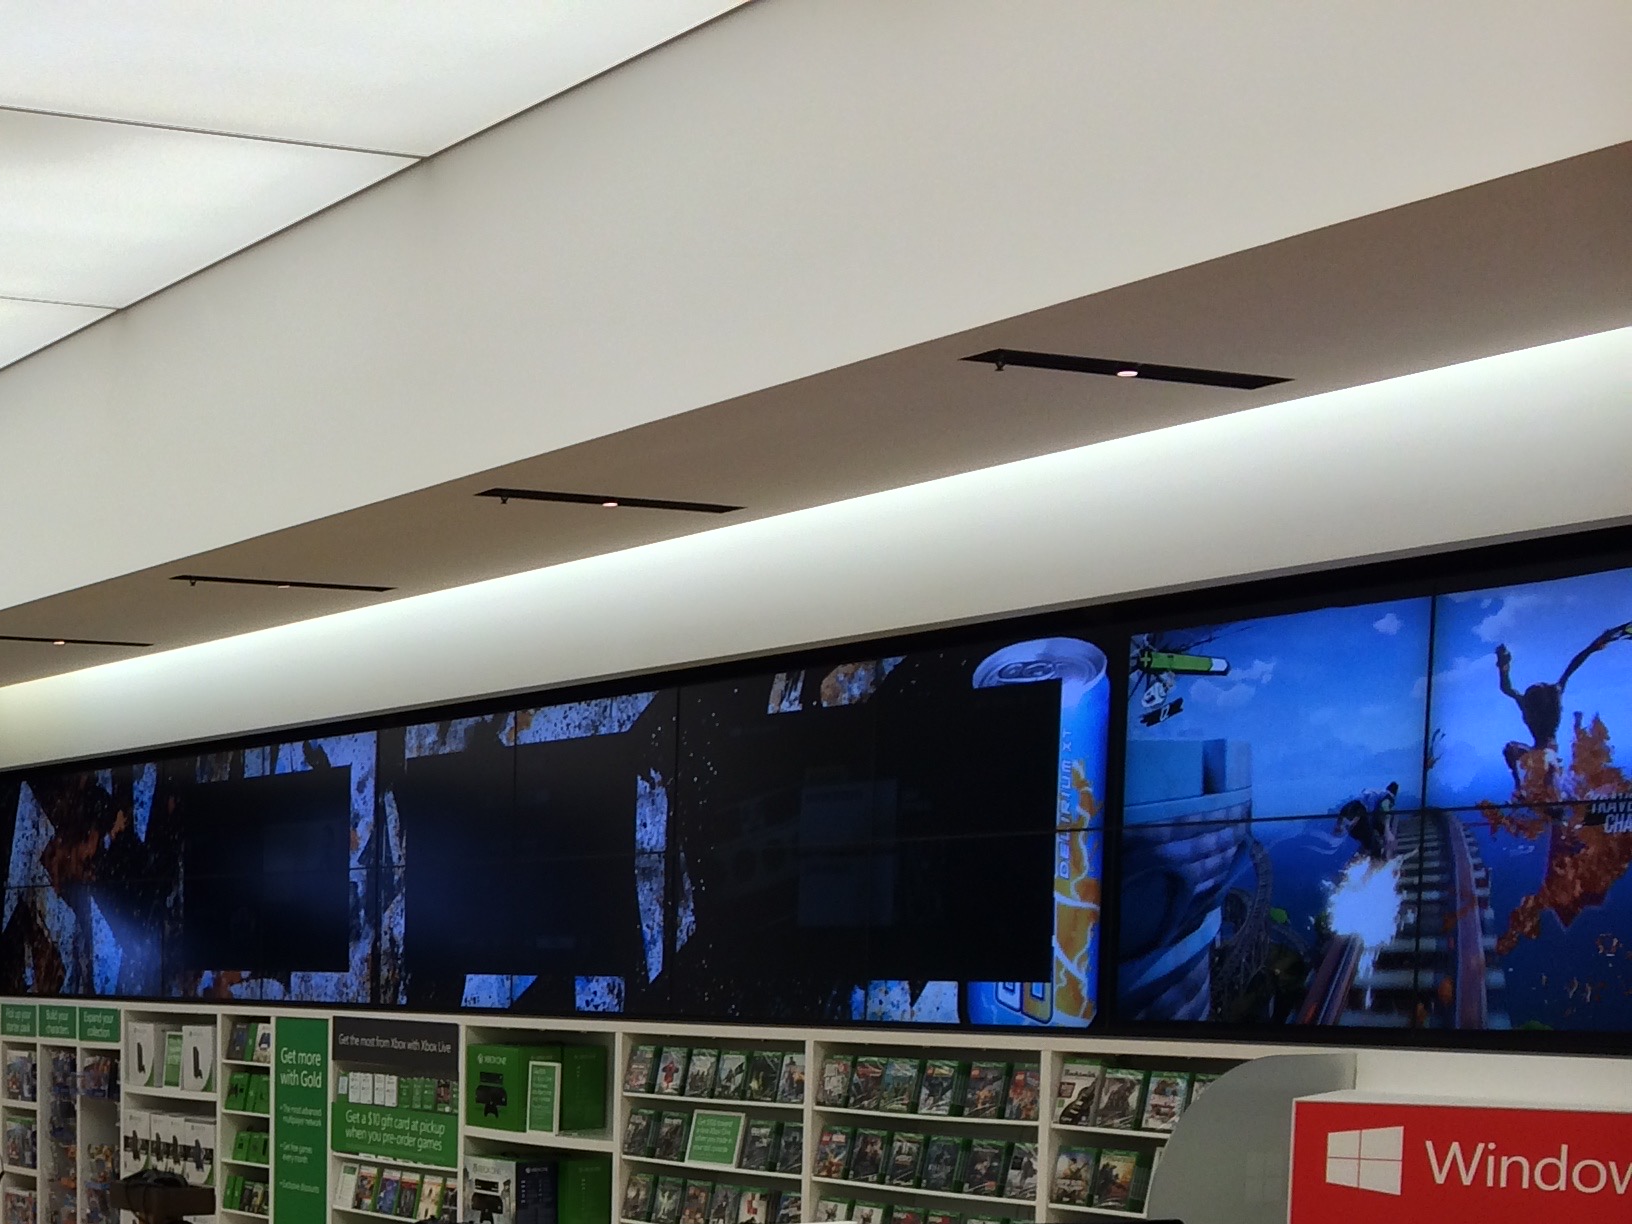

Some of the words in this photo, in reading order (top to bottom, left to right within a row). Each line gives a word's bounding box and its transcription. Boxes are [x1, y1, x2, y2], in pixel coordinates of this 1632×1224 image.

[1062, 729, 1072, 752] XT
[1058, 759, 1072, 878] DELIRIUM
[280, 1047, 296, 1064] Get
[298, 1051, 321, 1066] more
[280, 1070, 299, 1086] with
[300, 1071, 322, 1088] Gold
[346, 1109, 359, 1123] Get
[361, 1114, 367, 1124] a
[367, 1111, 380, 1126] $10
[381, 1113, 393, 1130] gift
[394, 1115, 410, 1131] card
[411, 1118, 419, 1131] at
[419, 1119, 445, 1138] pickup
[346, 1126, 367, 1140] when
[367, 1131, 381, 1144] you
[382, 1130, 416, 1147] pre-order
[417, 1137, 442, 1152] games
